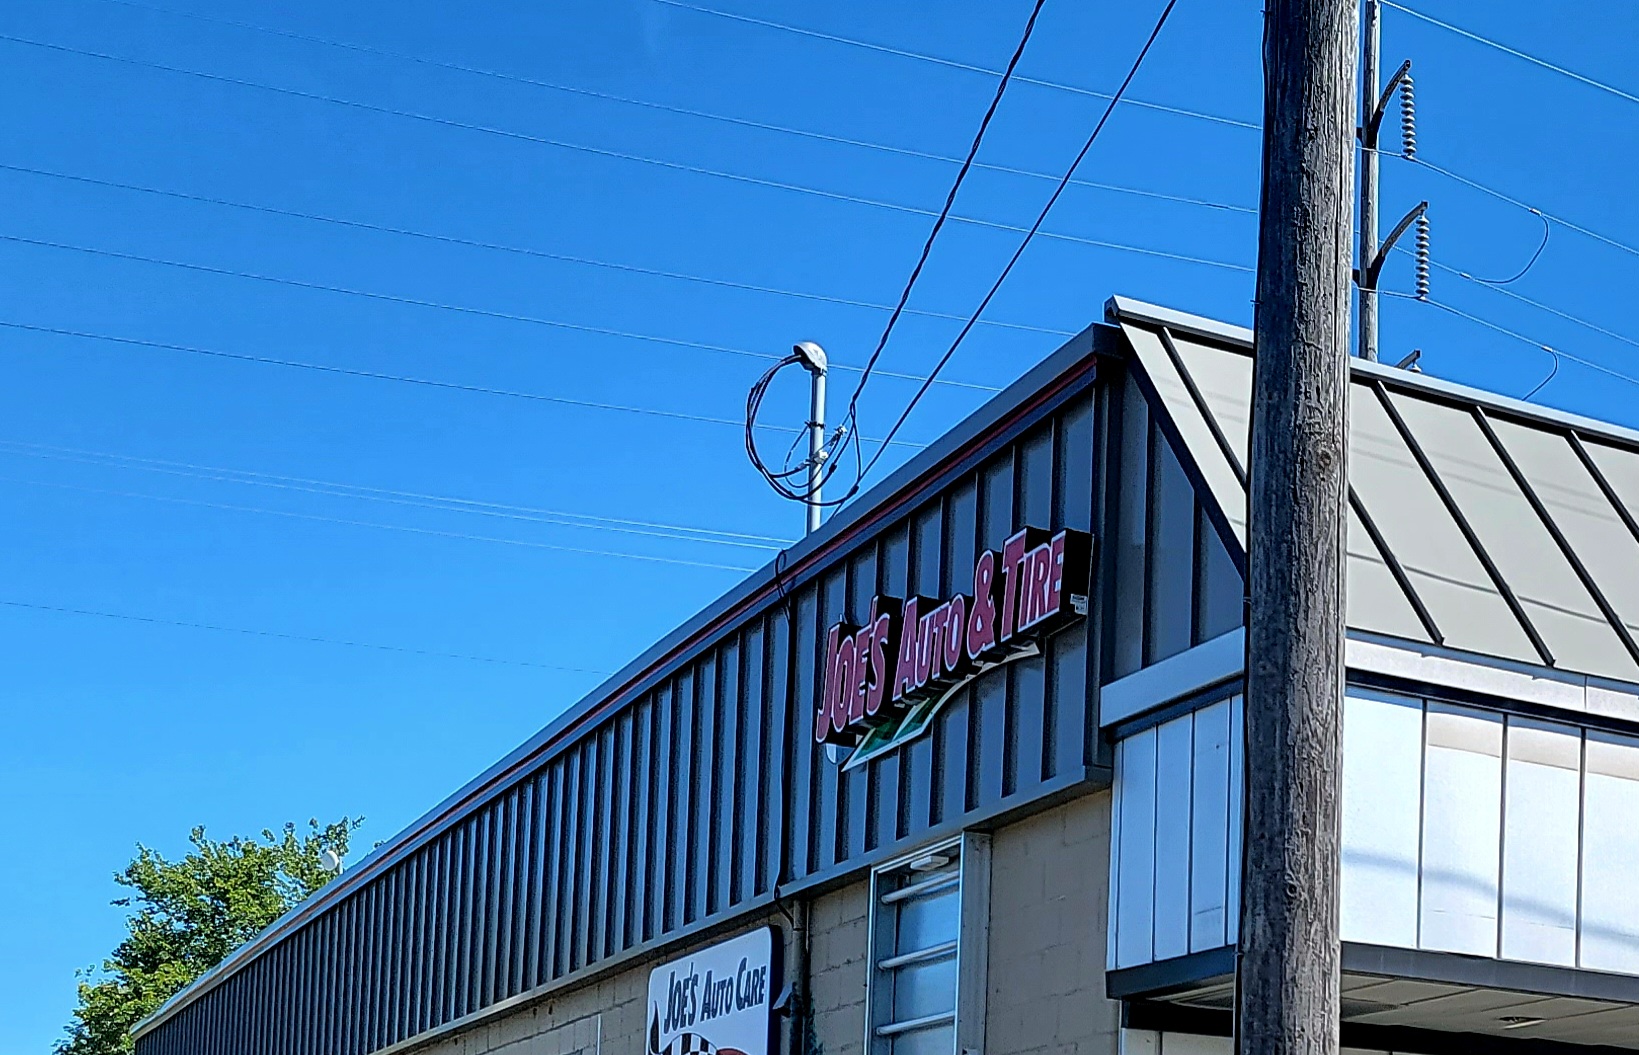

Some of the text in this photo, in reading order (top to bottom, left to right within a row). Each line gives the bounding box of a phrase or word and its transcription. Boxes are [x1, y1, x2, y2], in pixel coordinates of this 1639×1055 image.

[816, 527, 1068, 743] JOE'S AUTO & TIRE
[663, 957, 767, 1035] JOE'S AUTO CARE
